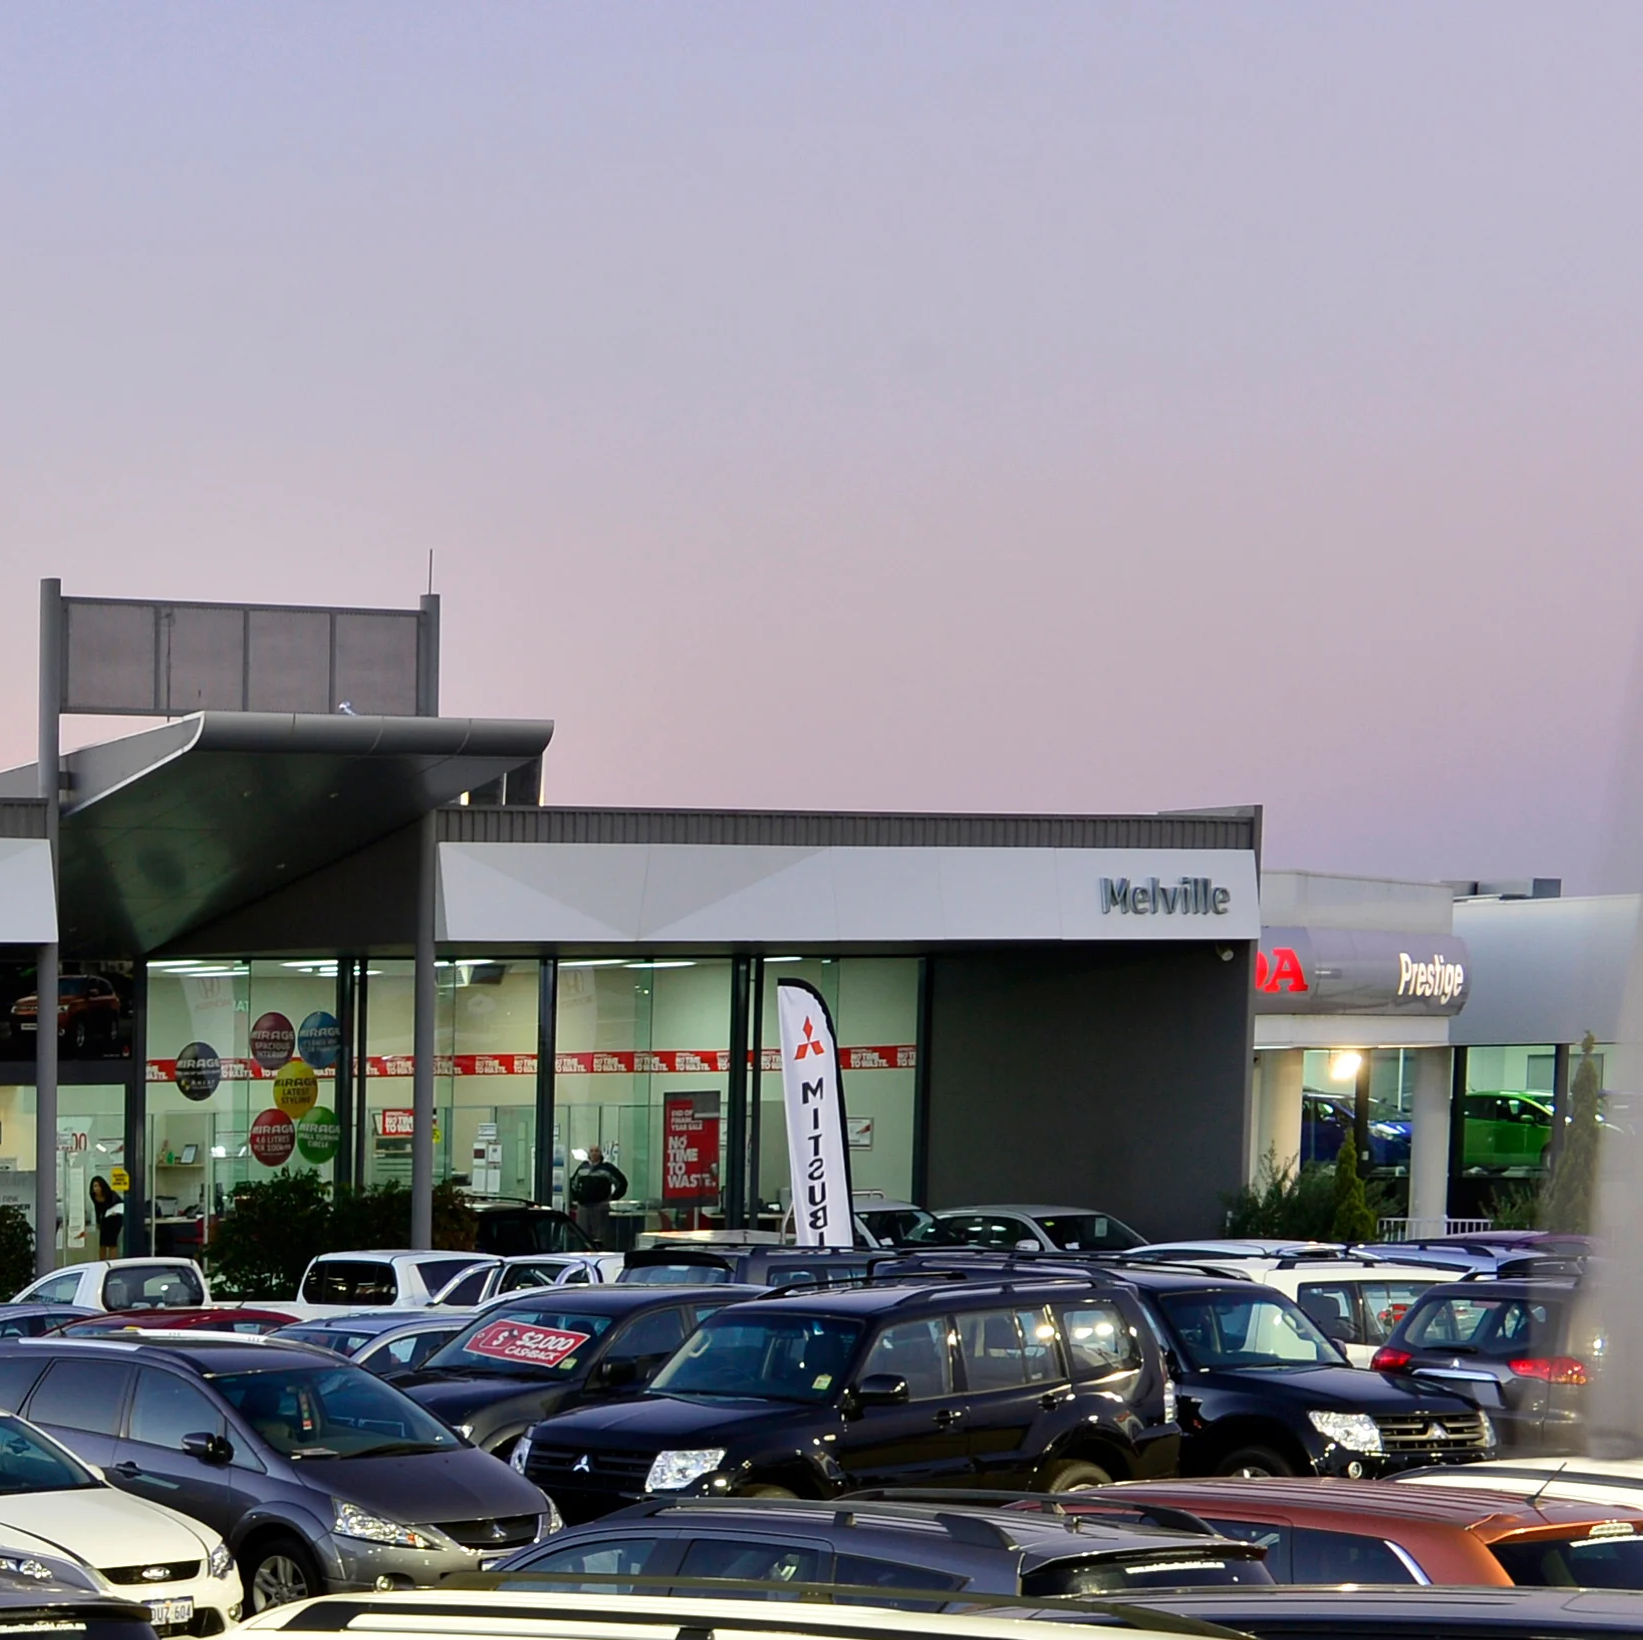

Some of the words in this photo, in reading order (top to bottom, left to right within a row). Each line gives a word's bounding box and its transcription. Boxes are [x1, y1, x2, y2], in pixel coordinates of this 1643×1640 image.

[1099, 877, 1231, 916] Melville
[1398, 953, 1464, 1004] Prestige
[668, 1135, 687, 1149] NO
[668, 1148, 698, 1162] TIME
[668, 1162, 686, 1175] TO
[516, 1331, 575, 1351] $2,000
[504, 1346, 561, 1360] CASHBACK
